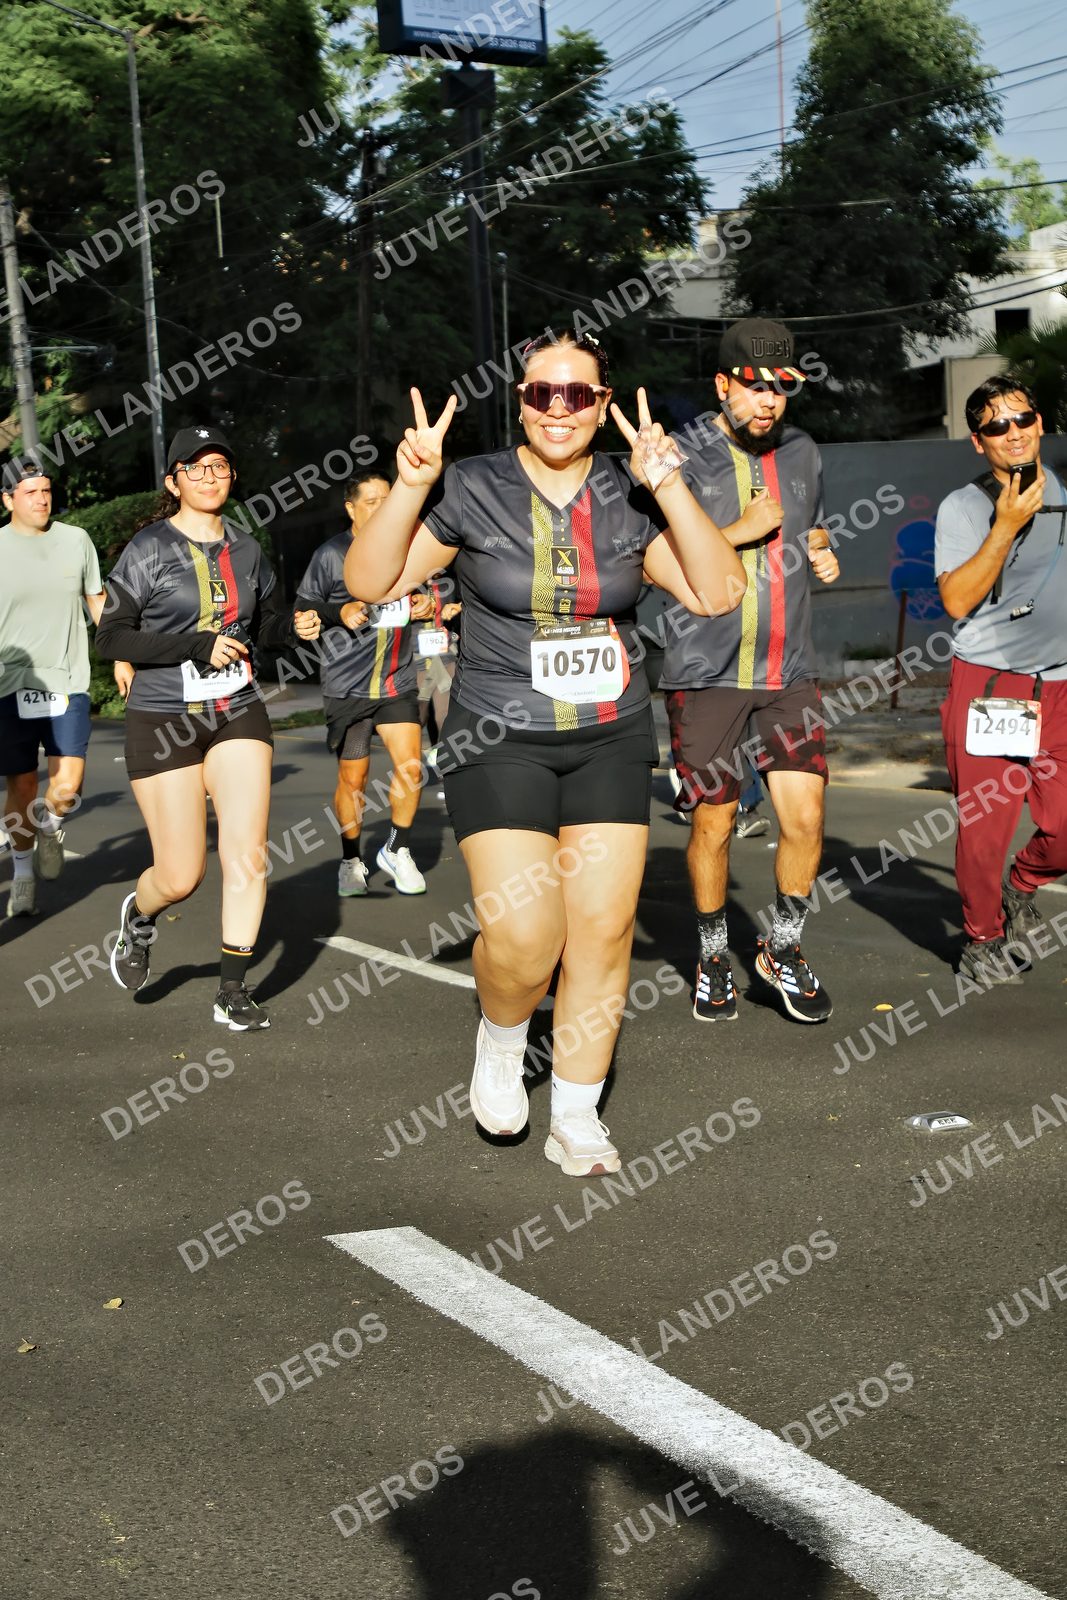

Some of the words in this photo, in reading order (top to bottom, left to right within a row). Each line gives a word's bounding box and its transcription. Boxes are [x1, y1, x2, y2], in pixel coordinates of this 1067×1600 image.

[537, 646, 616, 677] 10570
[23, 691, 57, 704] 4216
[973, 717, 1031, 735] 12494
